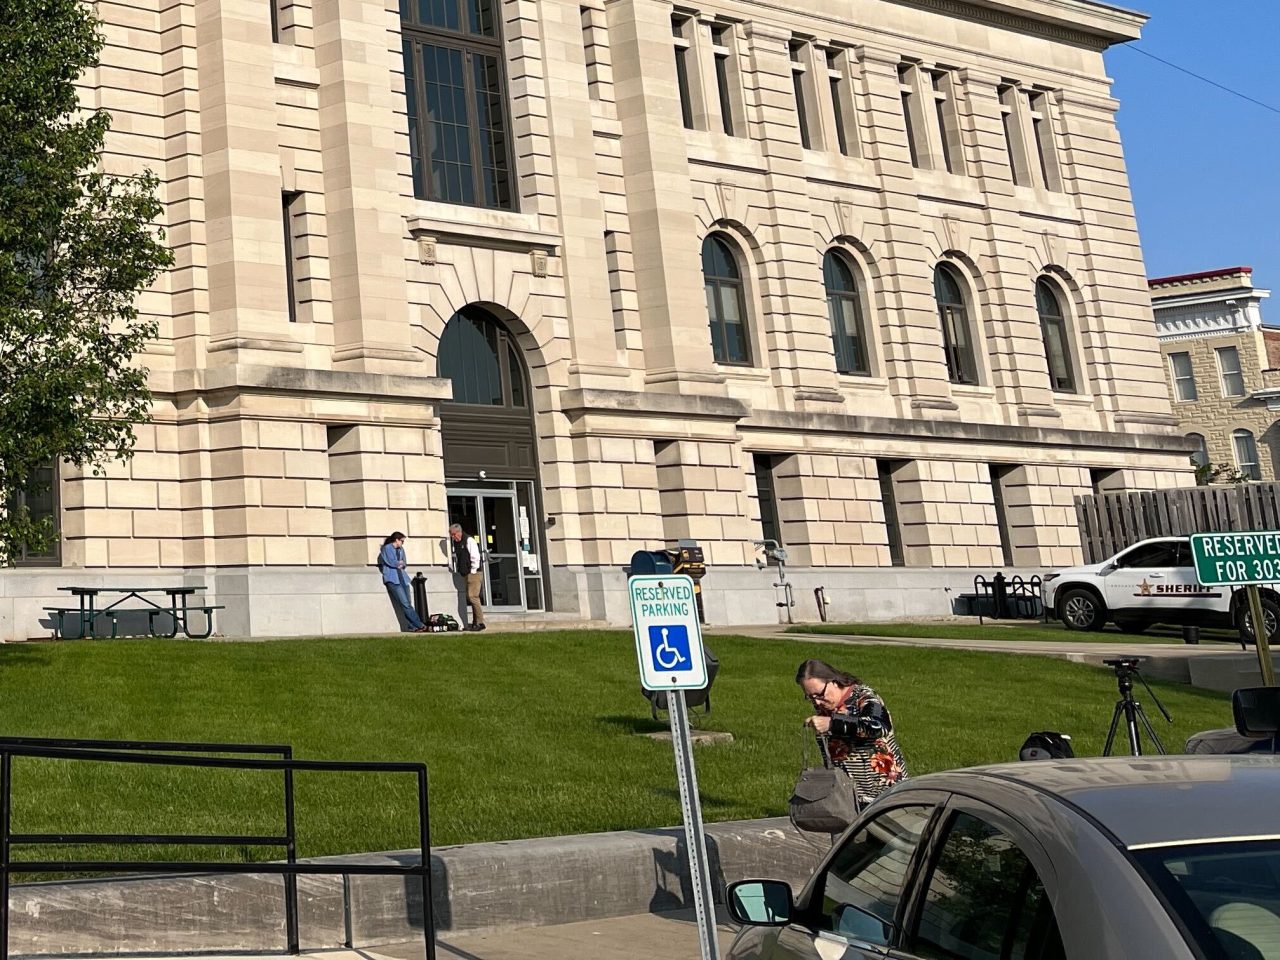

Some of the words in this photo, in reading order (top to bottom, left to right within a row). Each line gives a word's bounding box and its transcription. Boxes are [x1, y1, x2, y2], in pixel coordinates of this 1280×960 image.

[1215, 560, 1248, 581] FOR
[635, 586, 690, 601] RESERVED
[641, 602, 689, 617] PARKING
